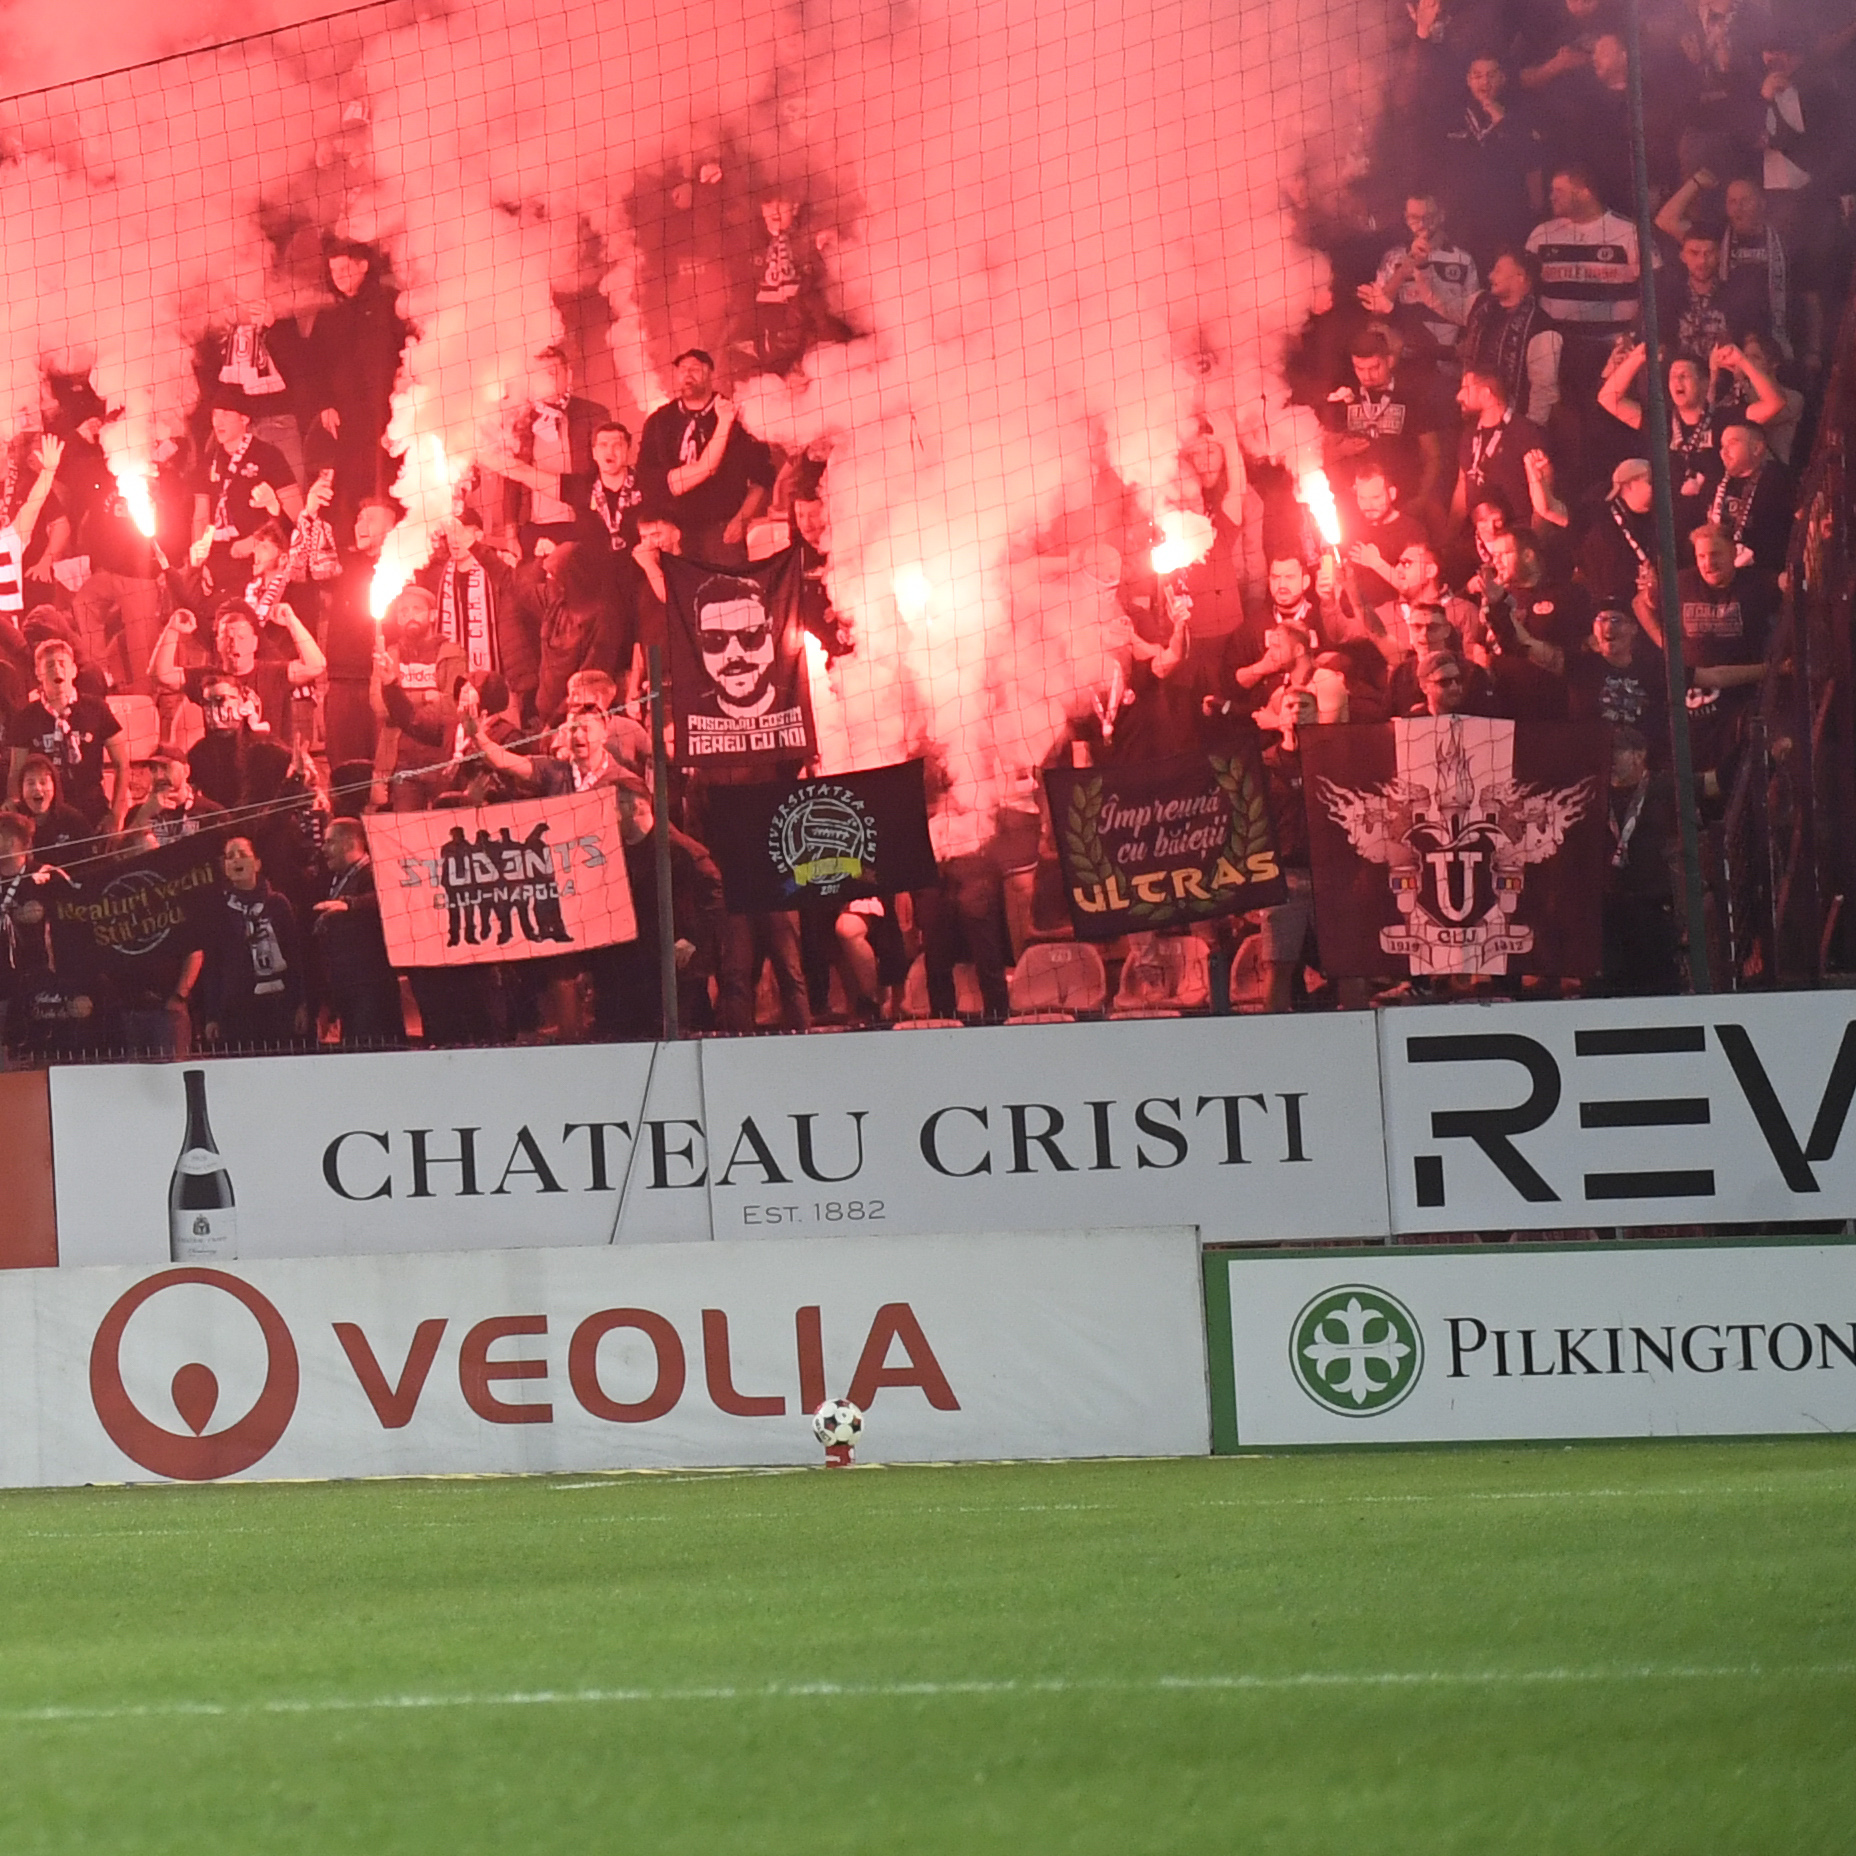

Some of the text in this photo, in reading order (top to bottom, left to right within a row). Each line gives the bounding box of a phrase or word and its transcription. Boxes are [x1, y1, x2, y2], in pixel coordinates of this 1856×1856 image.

[688, 727, 807, 756] MEREU CU NOI
[1117, 843, 1148, 864] cu
[156, 862, 215, 896] vechi
[1073, 850, 1280, 913] ULTRAS
[1425, 851, 1484, 922] U
[1437, 929, 1477, 945] CLUJ
[322, 1109, 870, 1203] CHATEAU
[919, 1093, 1314, 1179] CRISTI
[742, 1200, 887, 1226] EST. 1882
[332, 1301, 961, 1430] VEOLIA
